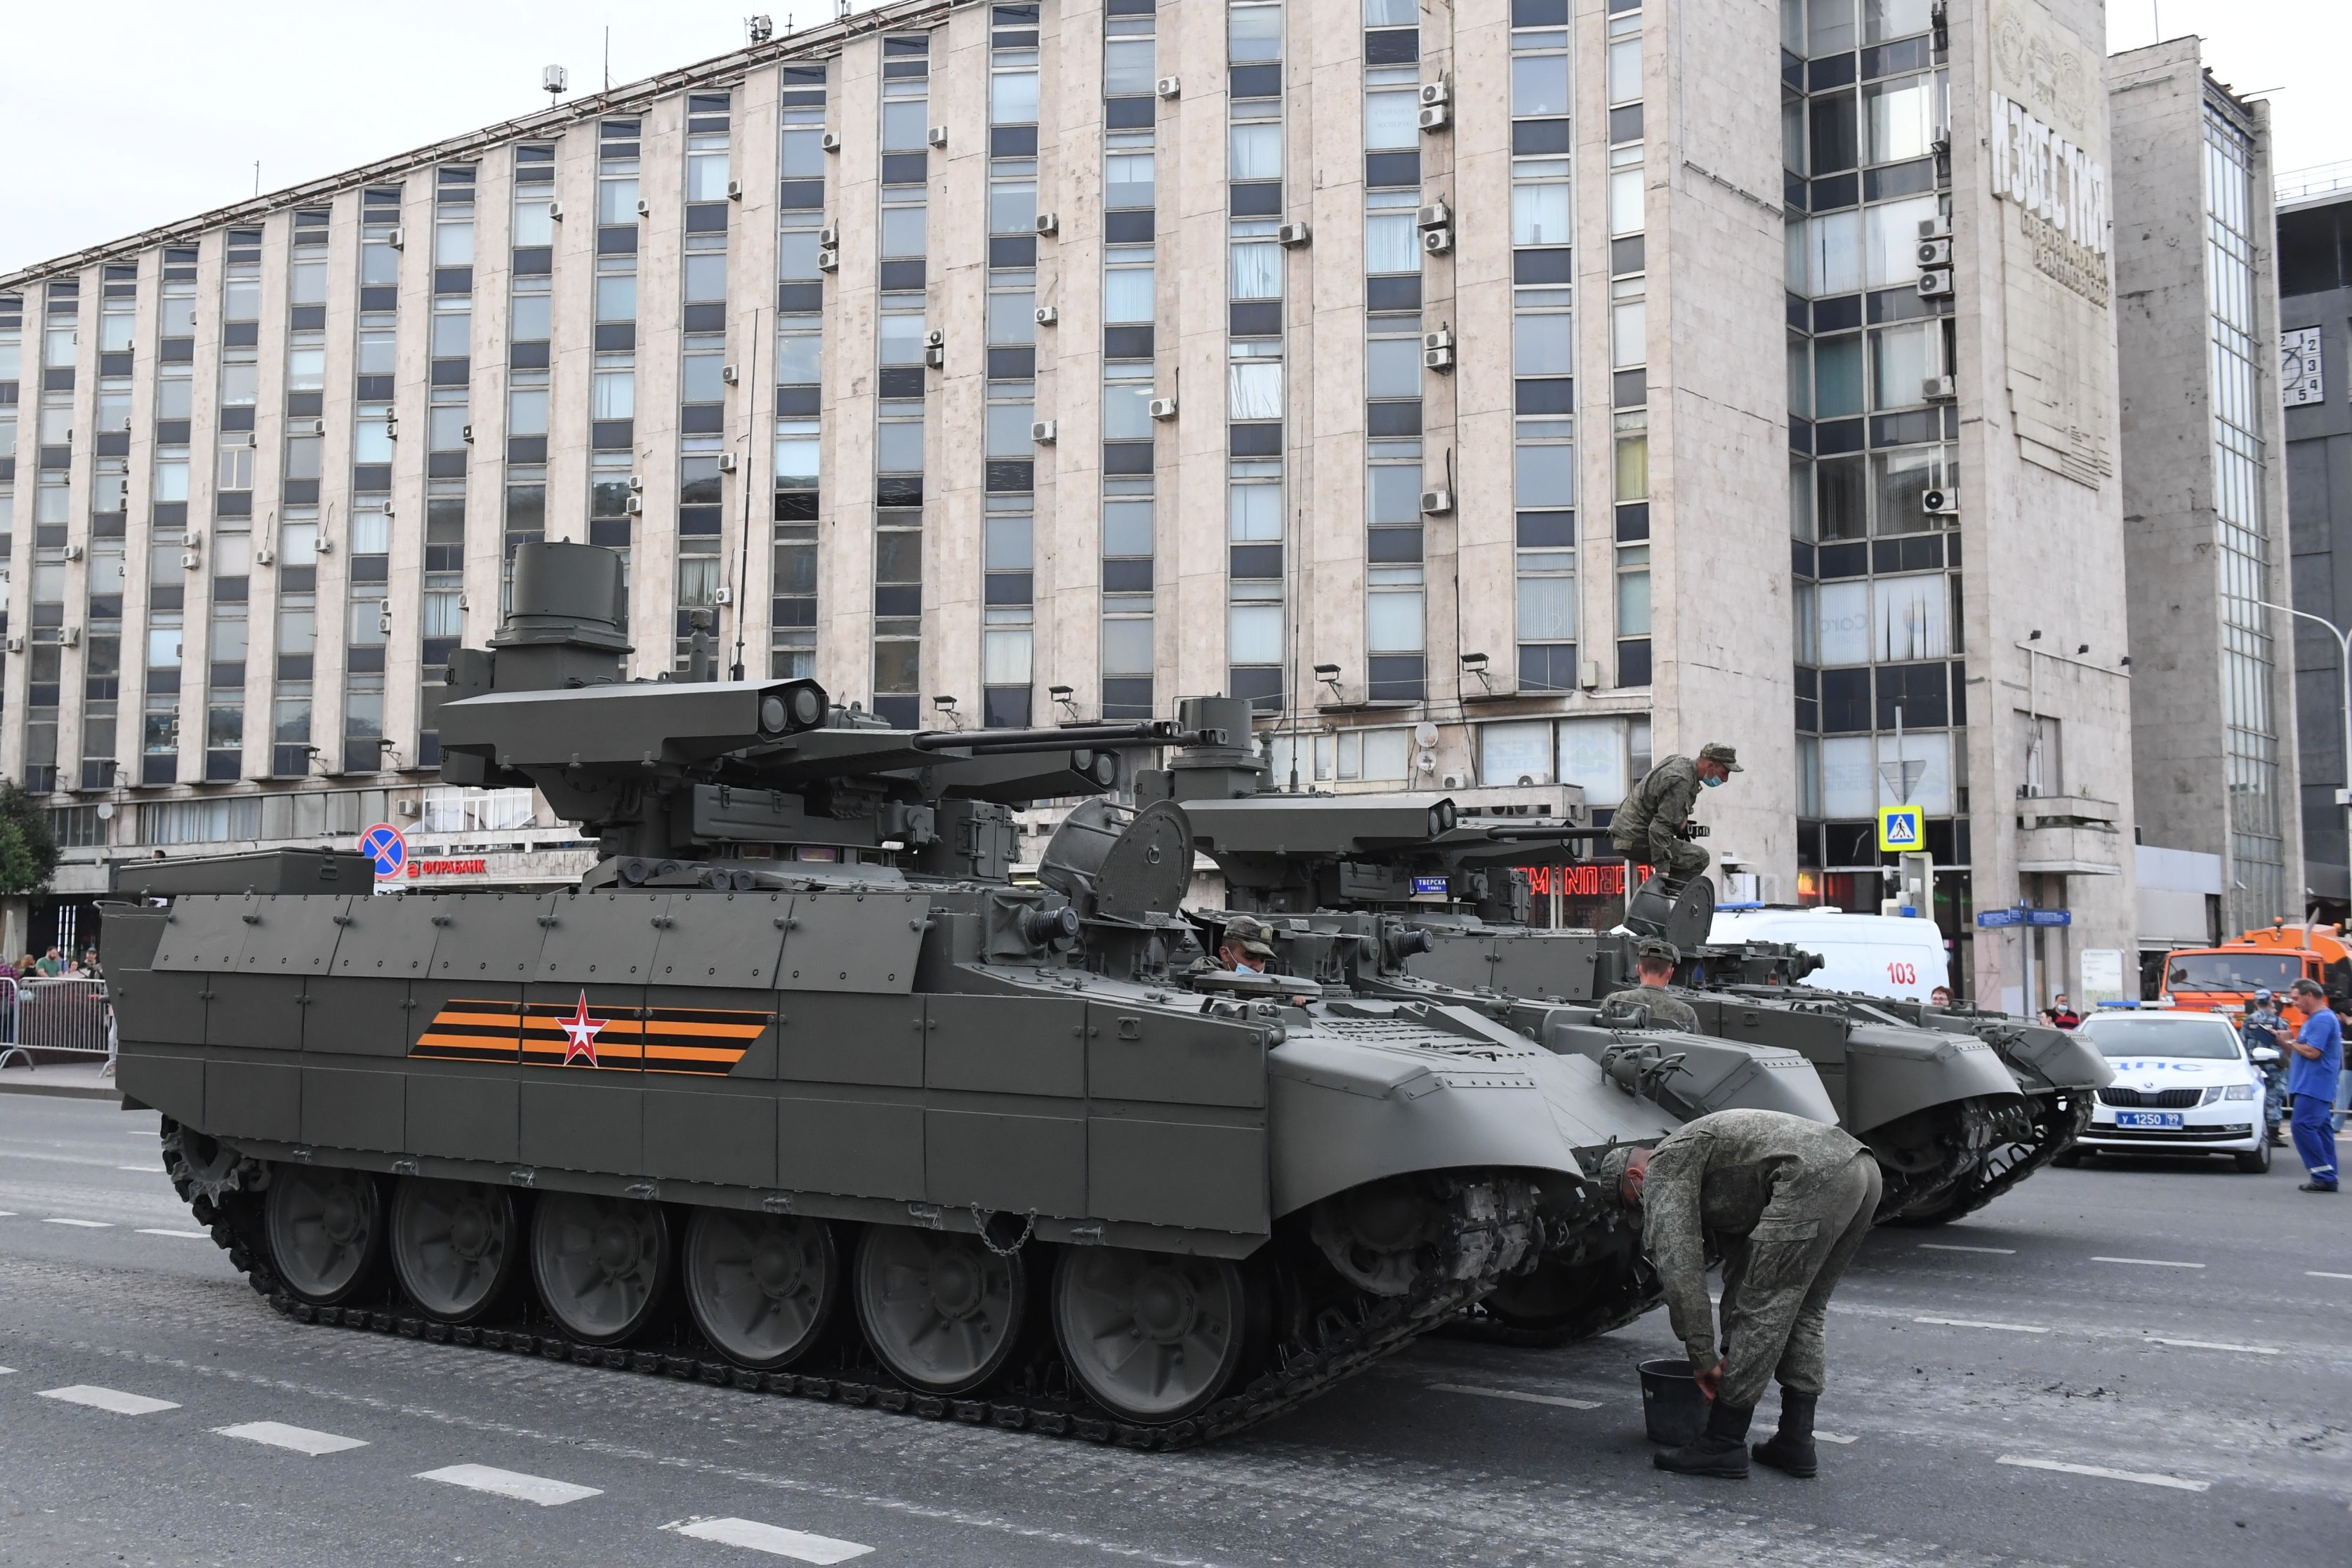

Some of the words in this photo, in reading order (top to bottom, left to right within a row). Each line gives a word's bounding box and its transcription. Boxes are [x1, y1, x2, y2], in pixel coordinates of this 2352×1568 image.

[1990, 89, 2106, 254] ИЗВЕСТИЯ
[2308, 339, 2316, 351] 2
[2308, 359, 2316, 371] 3
[2310, 380, 2318, 390] 4
[2299, 389, 2306, 401] 5
[1887, 962, 1916, 985] 103
[2134, 1115, 2161, 1124] 1250
[2167, 1114, 2179, 1122] 99
